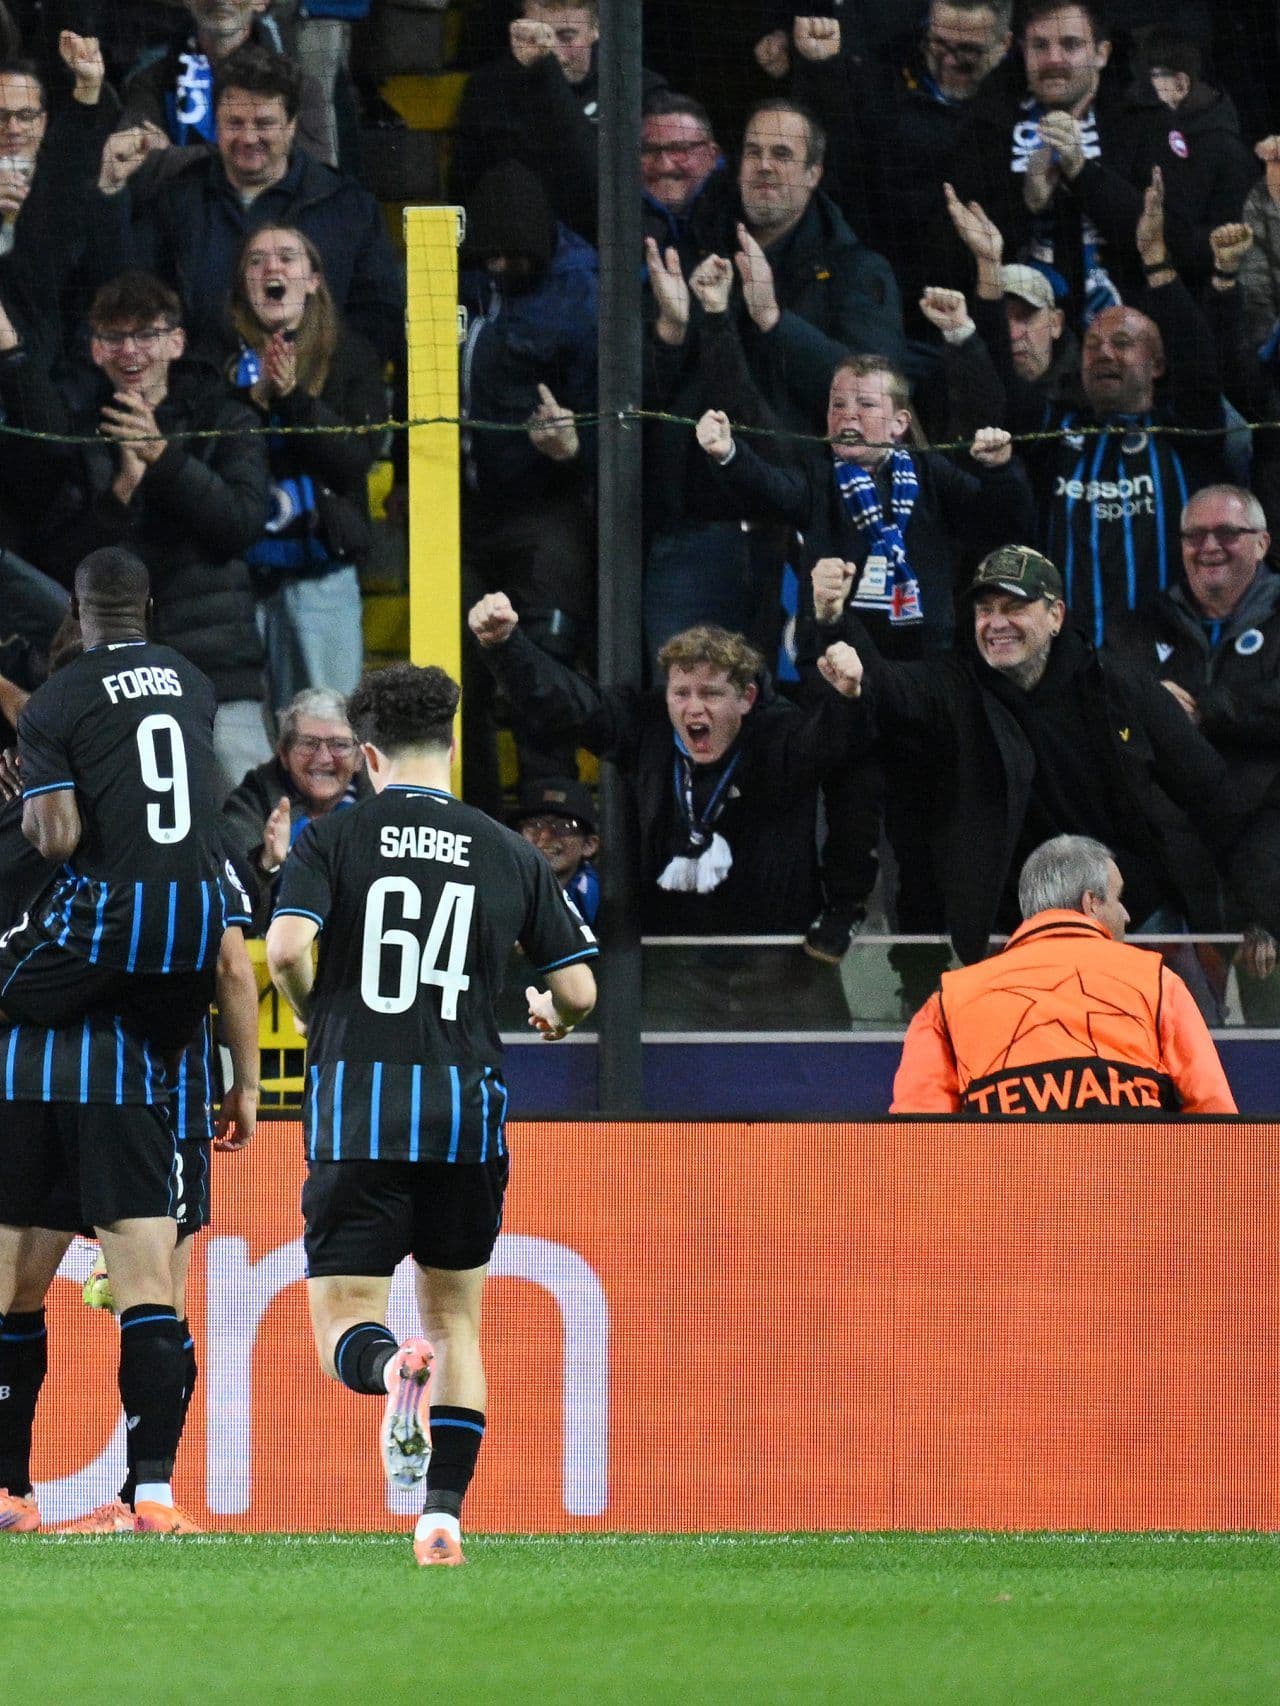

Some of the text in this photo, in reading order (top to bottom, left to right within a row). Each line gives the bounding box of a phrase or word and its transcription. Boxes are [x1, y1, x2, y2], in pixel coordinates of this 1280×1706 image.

[1096, 496, 1156, 522] sport
[102, 666, 183, 704] FORBS
[136, 713, 192, 844] 9
[380, 825, 473, 868] SABBE
[360, 875, 476, 1021] 64
[964, 1066, 1162, 1115] TEWARD
